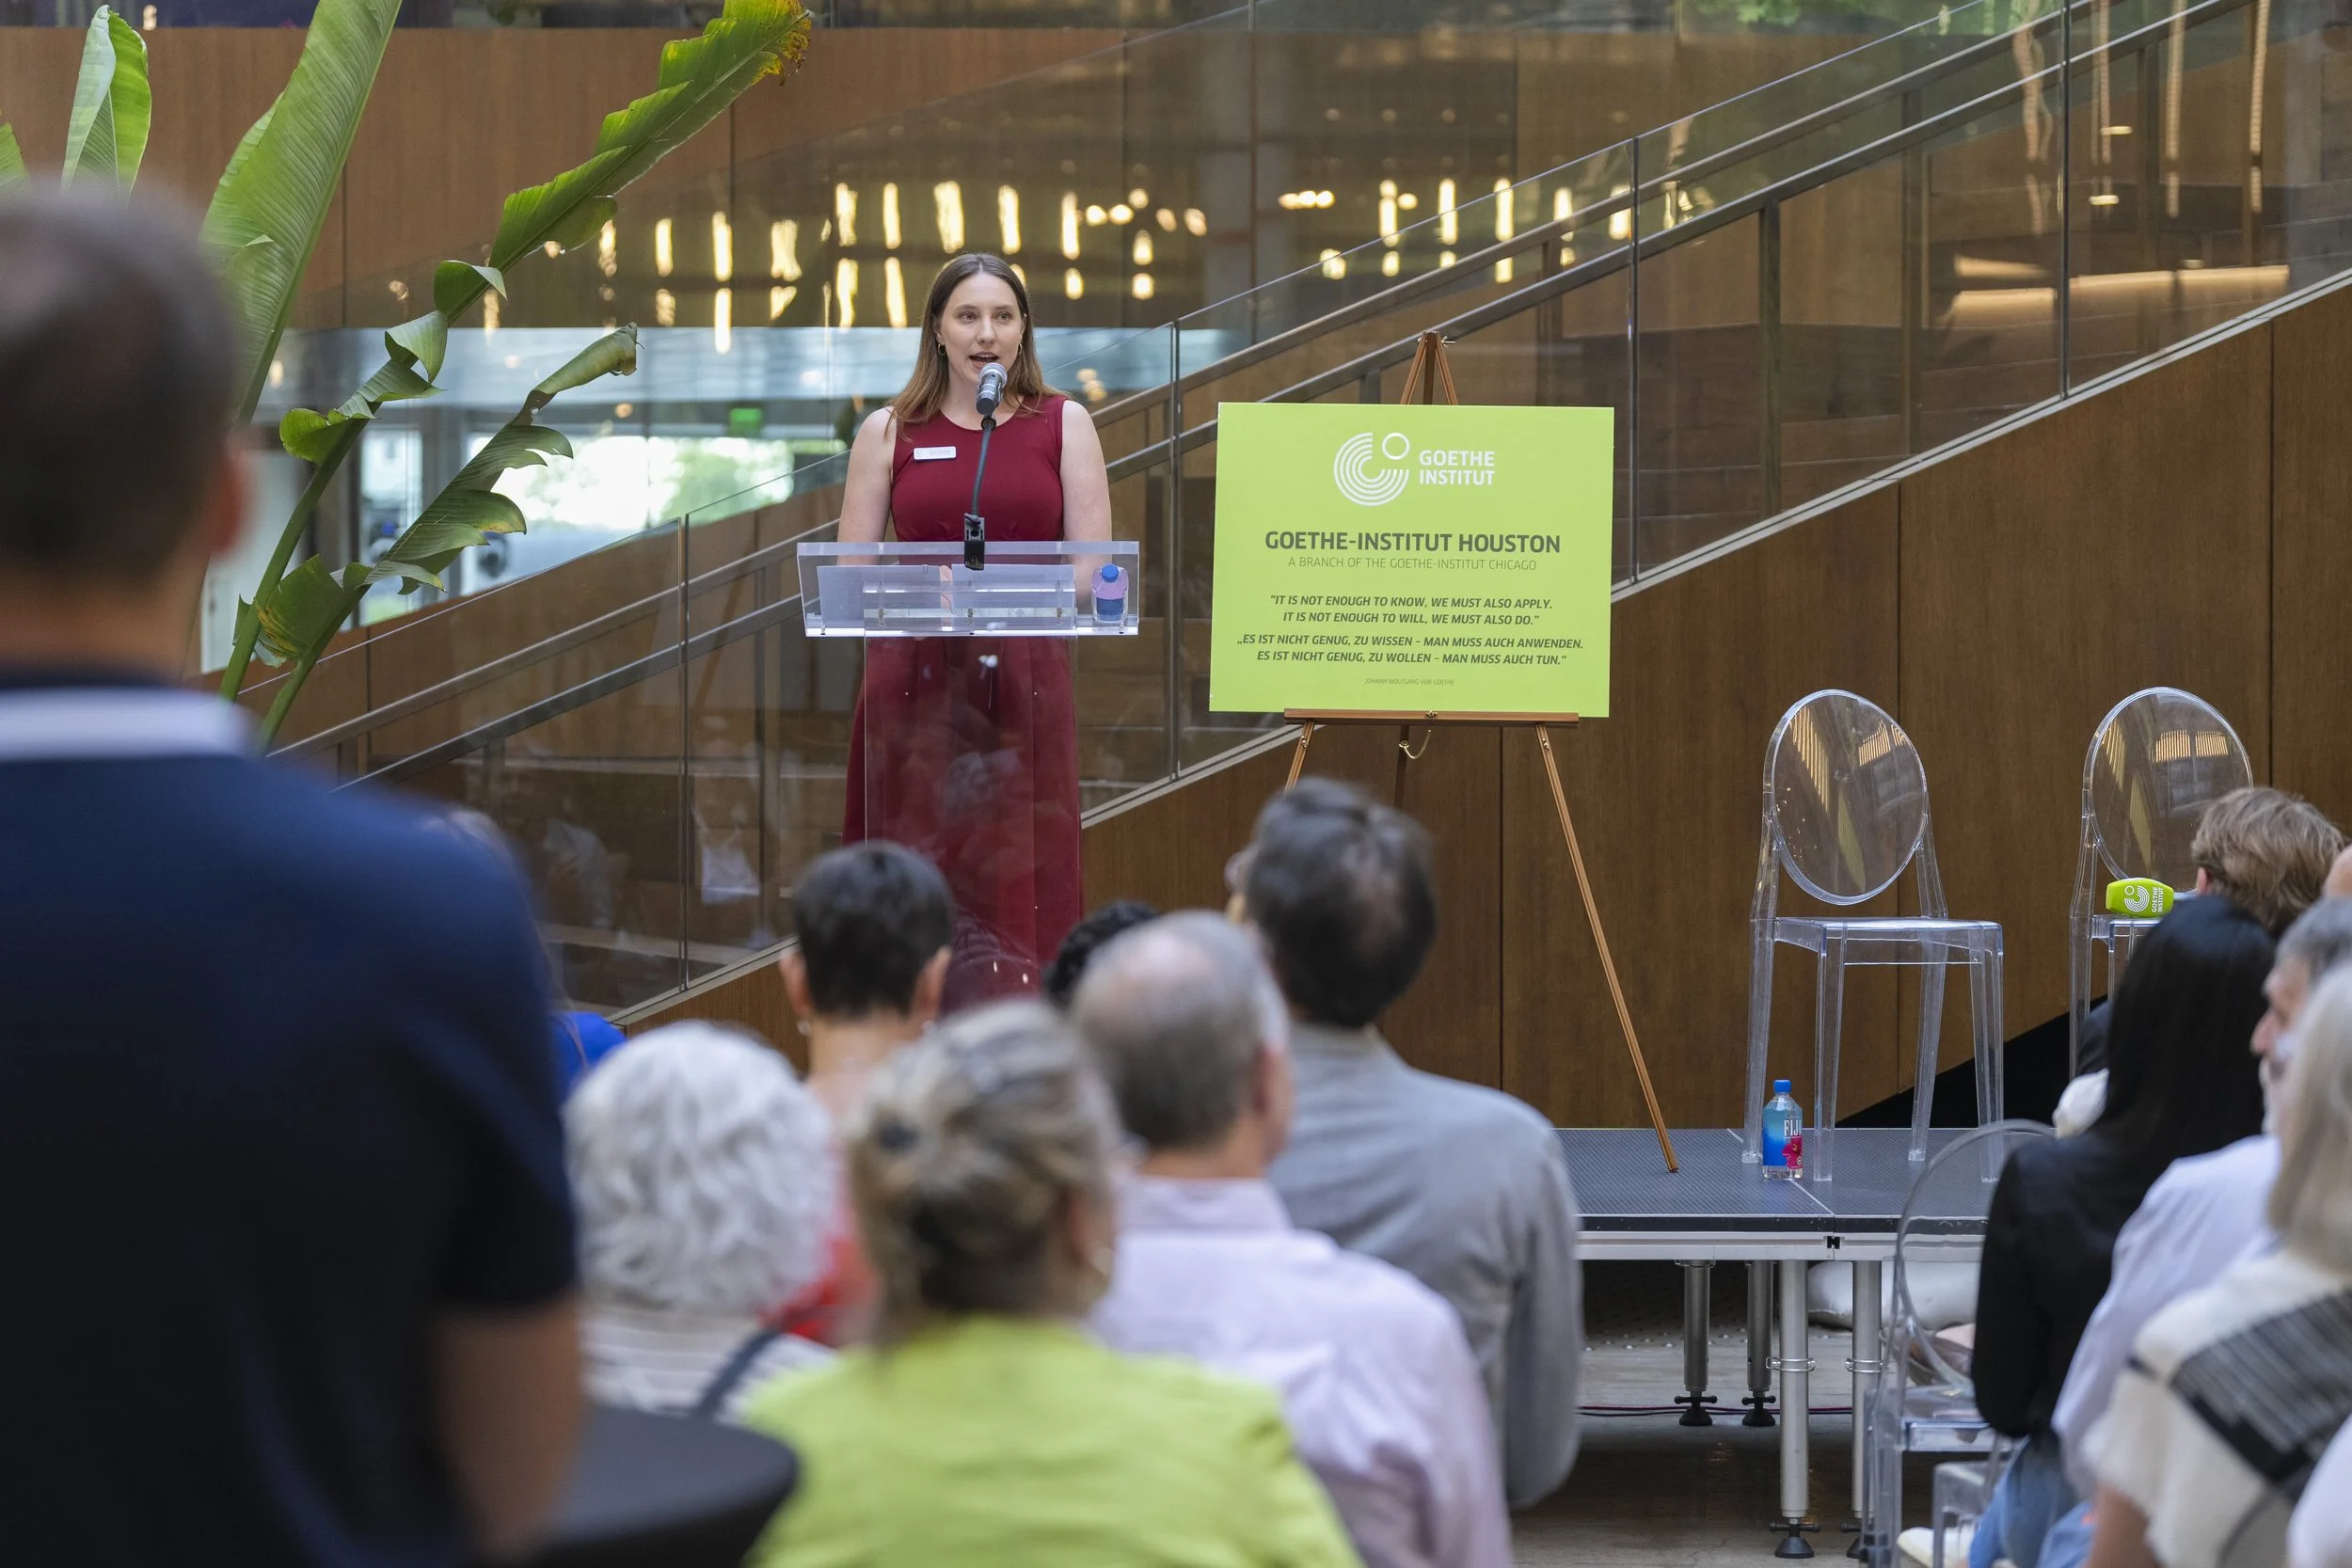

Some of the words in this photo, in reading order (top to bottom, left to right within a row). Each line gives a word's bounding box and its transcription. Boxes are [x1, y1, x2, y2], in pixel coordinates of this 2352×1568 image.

[1419, 450, 1495, 467] GOETHE
[1420, 469, 1495, 485] INSTITUT
[1264, 531, 1454, 552] GOETHE-INSTITUT
[1458, 533, 1561, 553] HOUSTON
[1287, 556, 1296, 567] A
[1298, 556, 1344, 568] BRANCH
[1347, 557, 1362, 568] OF
[1364, 557, 1387, 569] THE
[1390, 558, 1486, 570] GOETHE-INSTITUT
[1488, 559, 1537, 571] CHICAGO
[1287, 594, 1298, 606] IS
[1300, 595, 1325, 606] NOT
[1325, 595, 1372, 607] ENOUGH
[1373, 596, 1389, 607] TO
[1390, 596, 1428, 609] KNOW,
[1431, 597, 1450, 608] WE
[1451, 597, 1483, 609] MUST
[1483, 598, 1513, 609] ALSO
[1513, 598, 1552, 610] APPLY.
[1282, 611, 1295, 622] IT
[1295, 611, 1307, 622] IS
[1308, 611, 1332, 623] NOT
[1333, 612, 1379, 623] ENOUGH
[1381, 612, 1396, 624] TO
[1399, 613, 1428, 626] WILL,
[1431, 613, 1450, 625] WE
[1451, 613, 1483, 625] MUST
[1483, 614, 1513, 626] ALSO
[1258, 634, 1276, 644] IST
[1277, 634, 1311, 645] NICHT
[1311, 635, 1351, 646] GENUG,
[1353, 635, 1369, 646] ZU
[1371, 636, 1413, 646] WISSEN
[1422, 636, 1450, 647] MAN
[1452, 637, 1483, 647] MUSS
[1484, 637, 1515, 648] AUCH
[1516, 638, 1583, 649] ANWENDEN.
[1256, 650, 1271, 661] ES
[1272, 650, 1290, 661] IST
[1291, 651, 1325, 661] NICHT
[1326, 651, 1366, 663] GENUG,
[1368, 652, 1384, 662] ZU
[1386, 652, 1432, 663] WOLLEN
[1441, 653, 1469, 664] MAN
[1470, 654, 1502, 664] MUSS
[1502, 654, 1534, 665] AUCH
[1784, 1119, 1802, 1136] FIJI
